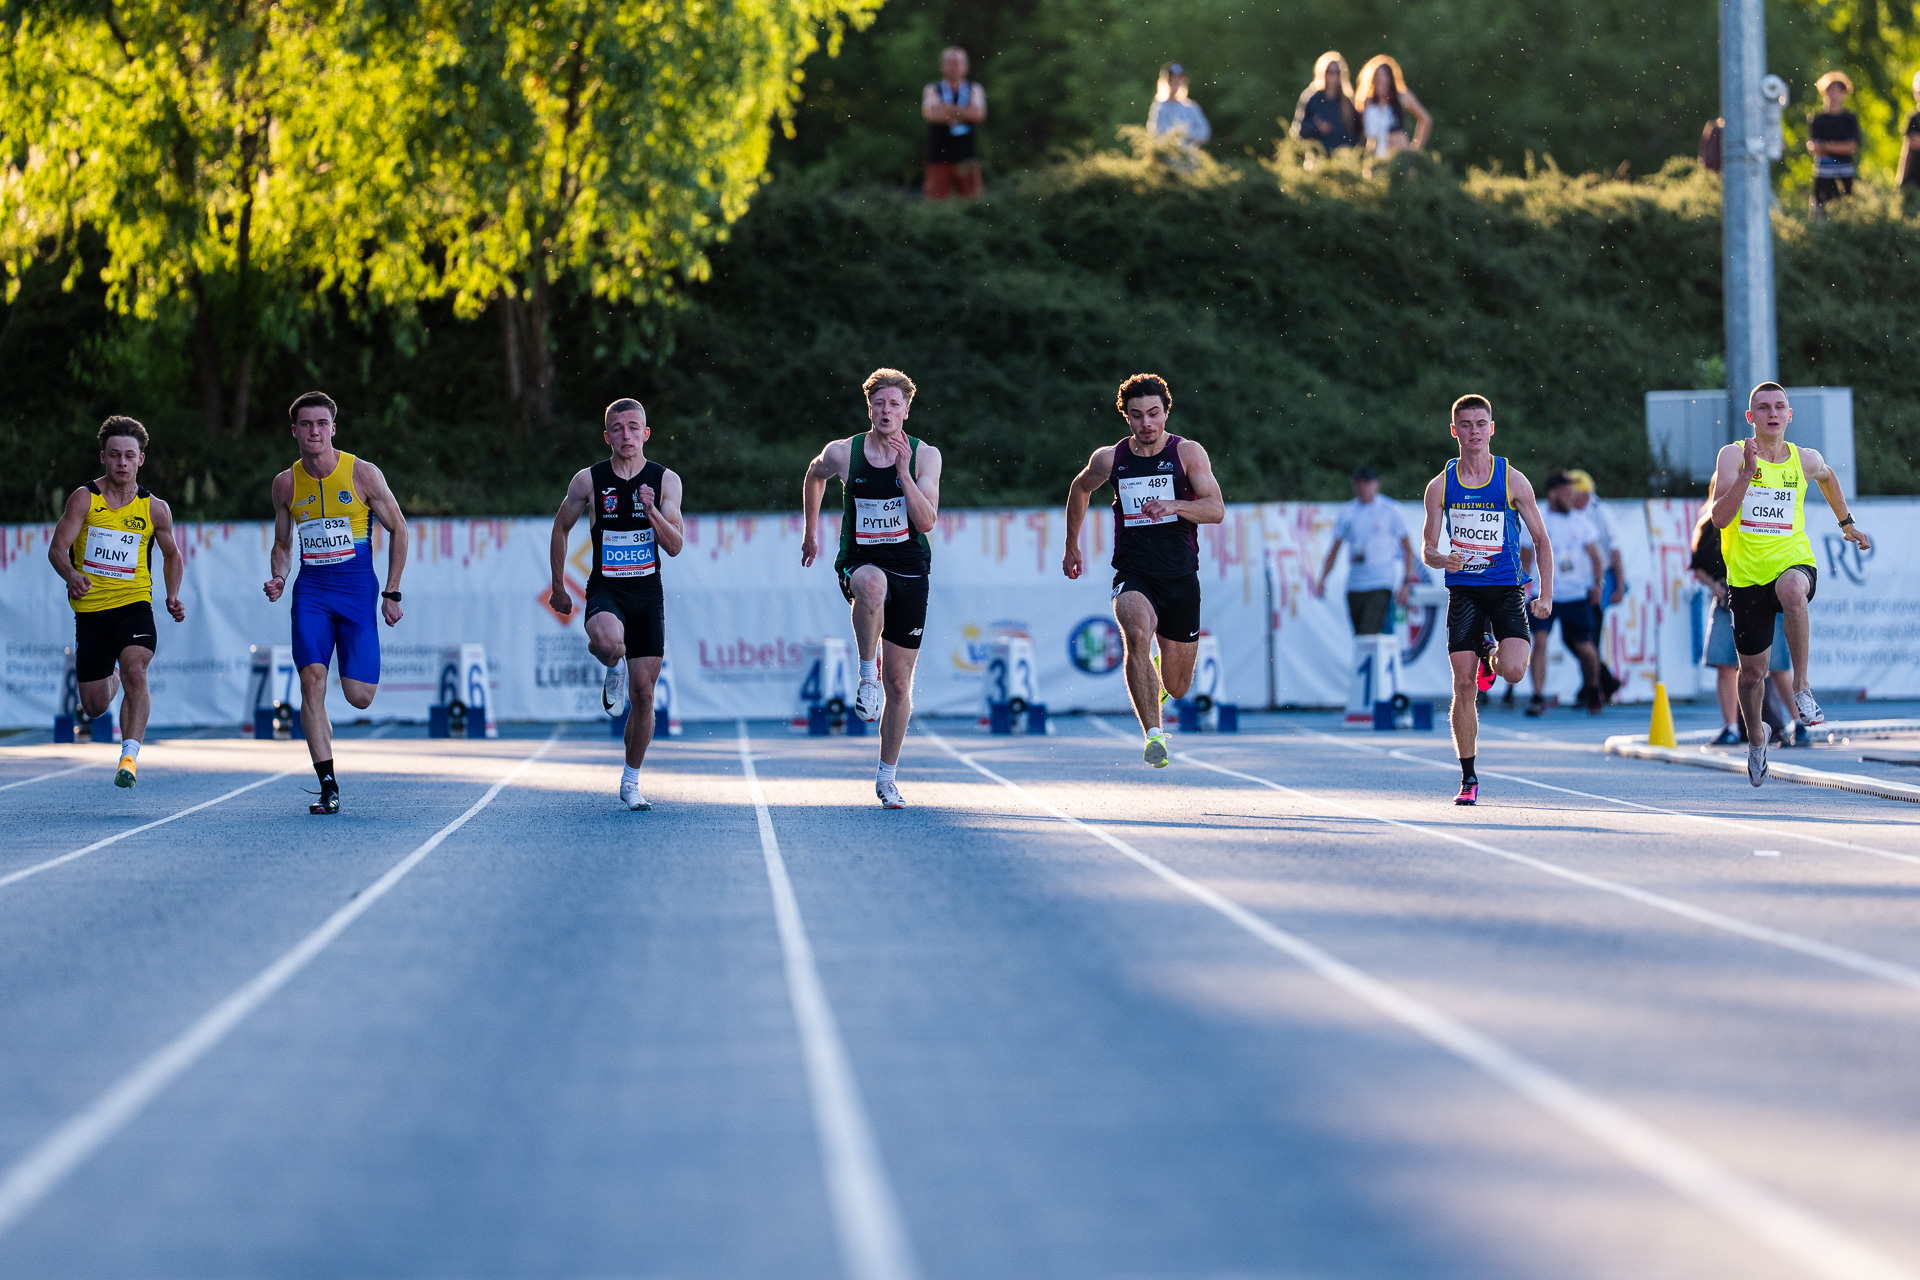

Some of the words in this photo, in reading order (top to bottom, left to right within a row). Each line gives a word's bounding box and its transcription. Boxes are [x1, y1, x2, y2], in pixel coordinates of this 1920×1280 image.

[1147, 477, 1168, 489] 489
[1773, 491, 1792, 501] 381
[883, 499, 902, 512] 624
[1451, 502, 1495, 510] KRUSZWICA
[1752, 506, 1784, 519] CISAK
[324, 519, 346, 530] 832
[862, 516, 901, 529] PYTLIK
[1479, 513, 1500, 523] 104
[120, 534, 134, 545] 43
[632, 531, 651, 543] 382
[1454, 525, 1498, 541] PROCEK
[303, 535, 352, 549] RACHUTA
[94, 546, 129, 562] PILNY
[606, 548, 652, 563] DOŁĘGA
[698, 635, 806, 669] Lubels
[277, 664, 295, 704] 7
[440, 662, 459, 707] 6
[534, 664, 606, 690] LUBEL
[800, 659, 823, 704] 4
[987, 657, 1008, 703] 3
[1356, 653, 1373, 708] 1
[252, 664, 271, 707] 7
[467, 662, 487, 708] 6
